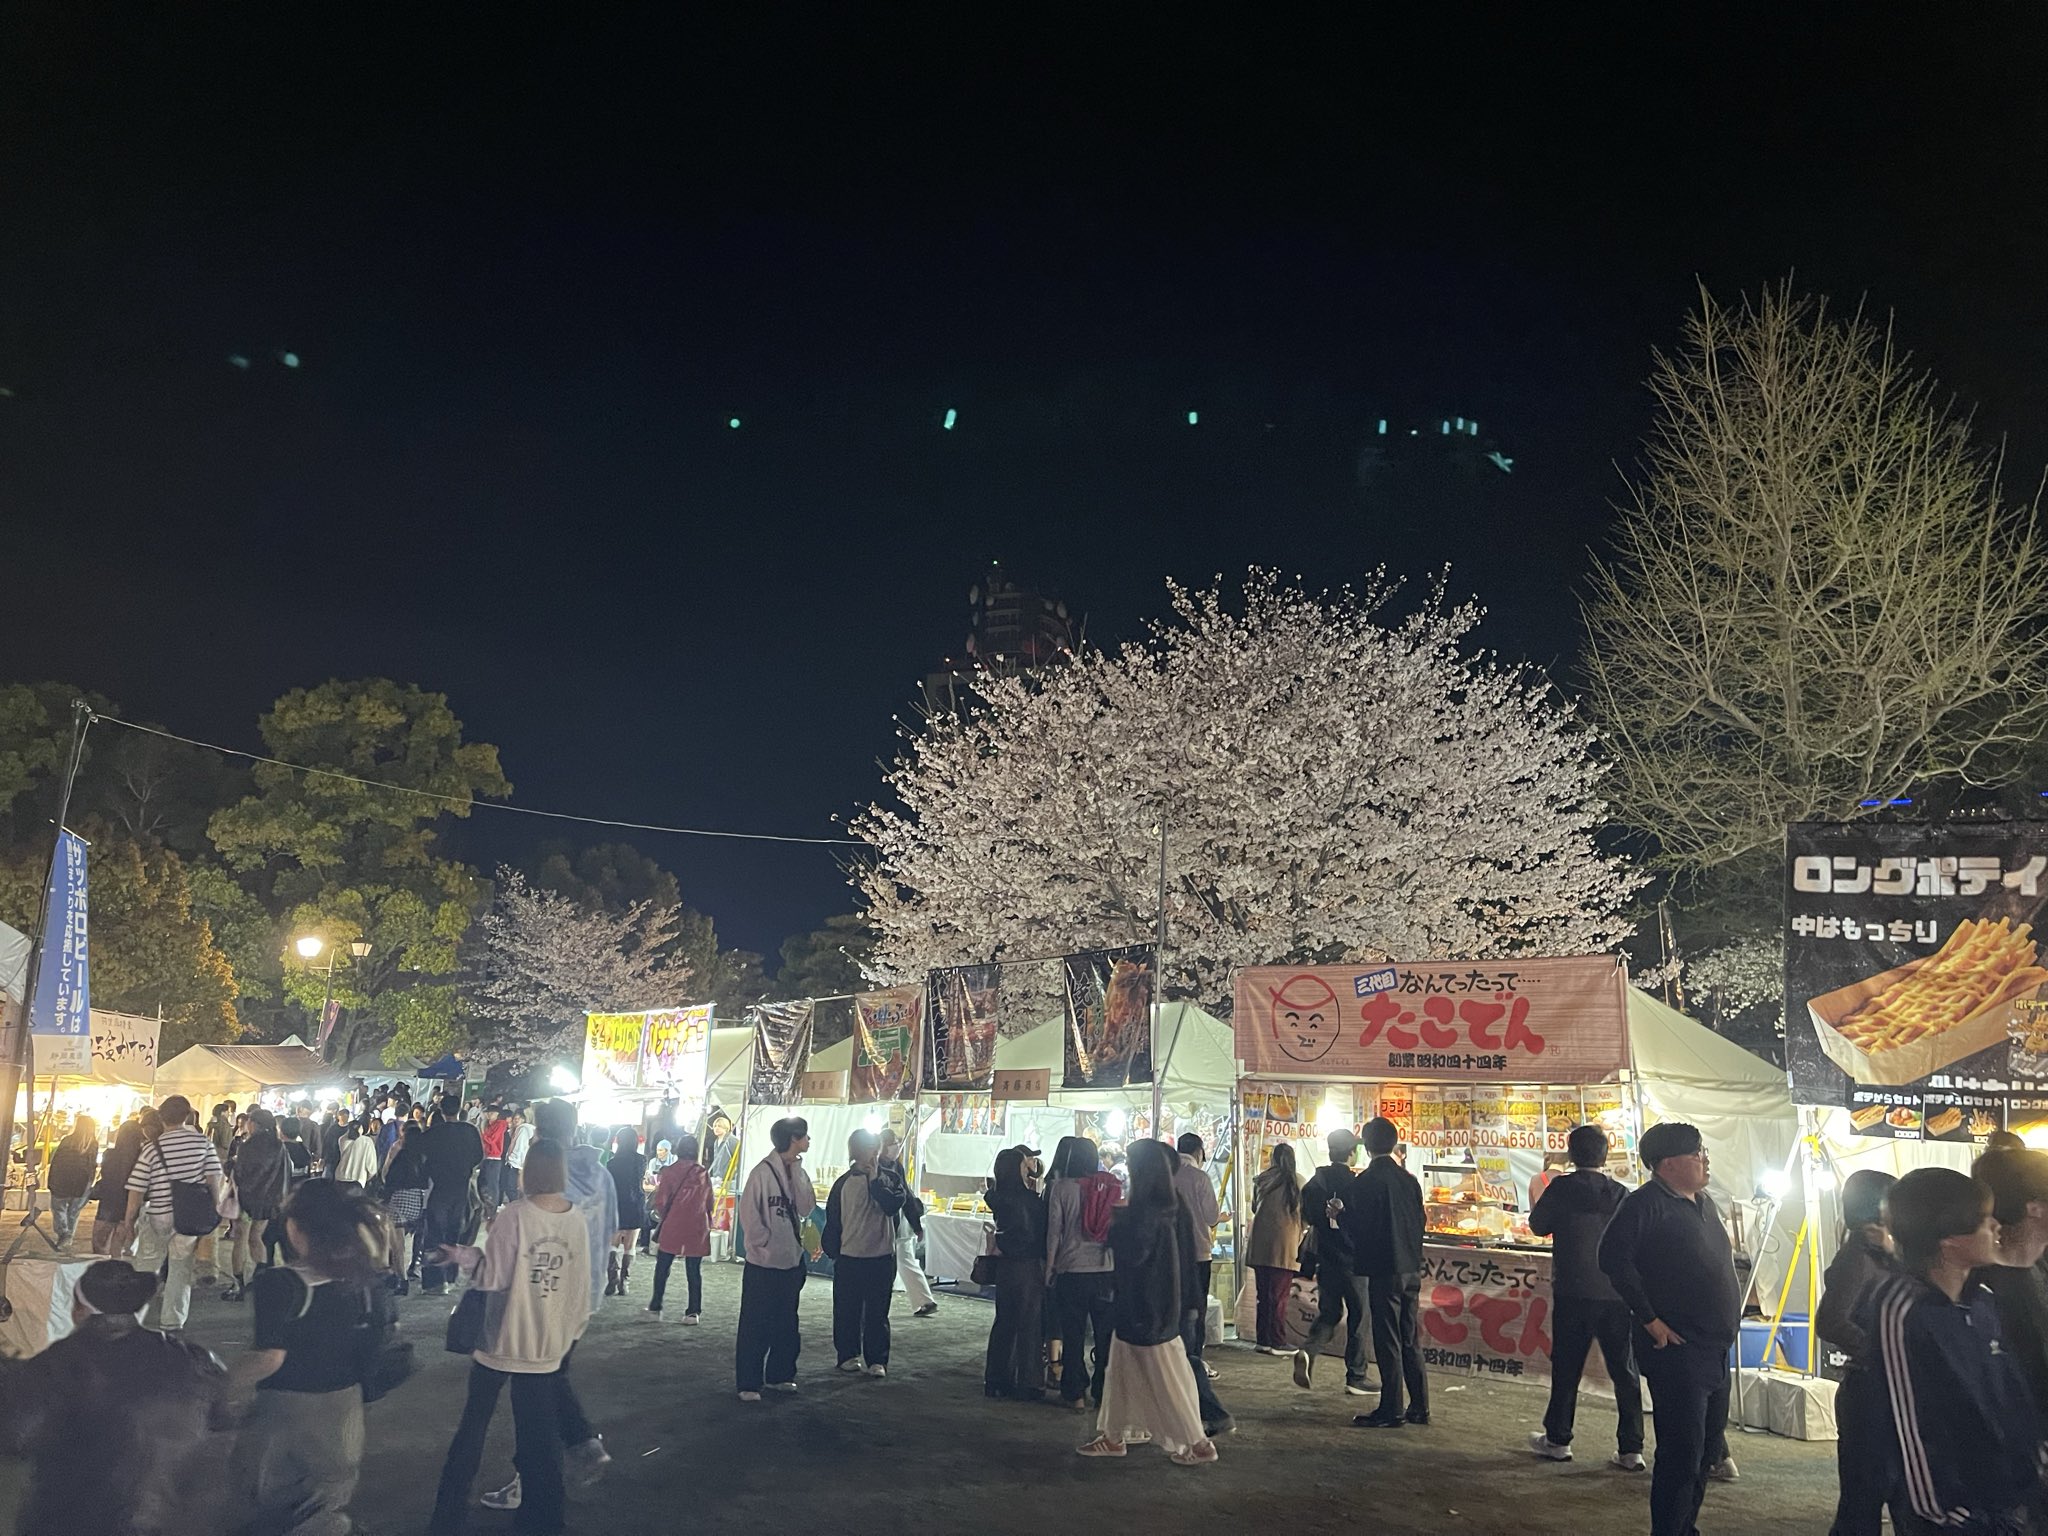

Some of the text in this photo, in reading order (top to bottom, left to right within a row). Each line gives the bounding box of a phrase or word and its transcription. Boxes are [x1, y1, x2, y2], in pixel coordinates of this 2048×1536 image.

[69, 842, 88, 1033] サッポロビールは
[1791, 914, 1938, 944] 中はもっちり
[1356, 971, 1396, 995] 三代目
[1359, 992, 1545, 1055] たこでん
[1388, 1052, 1508, 1070] 創業昭和四十四年
[1548, 1133, 1571, 1150] 65
[1420, 1284, 1552, 1361] こでん
